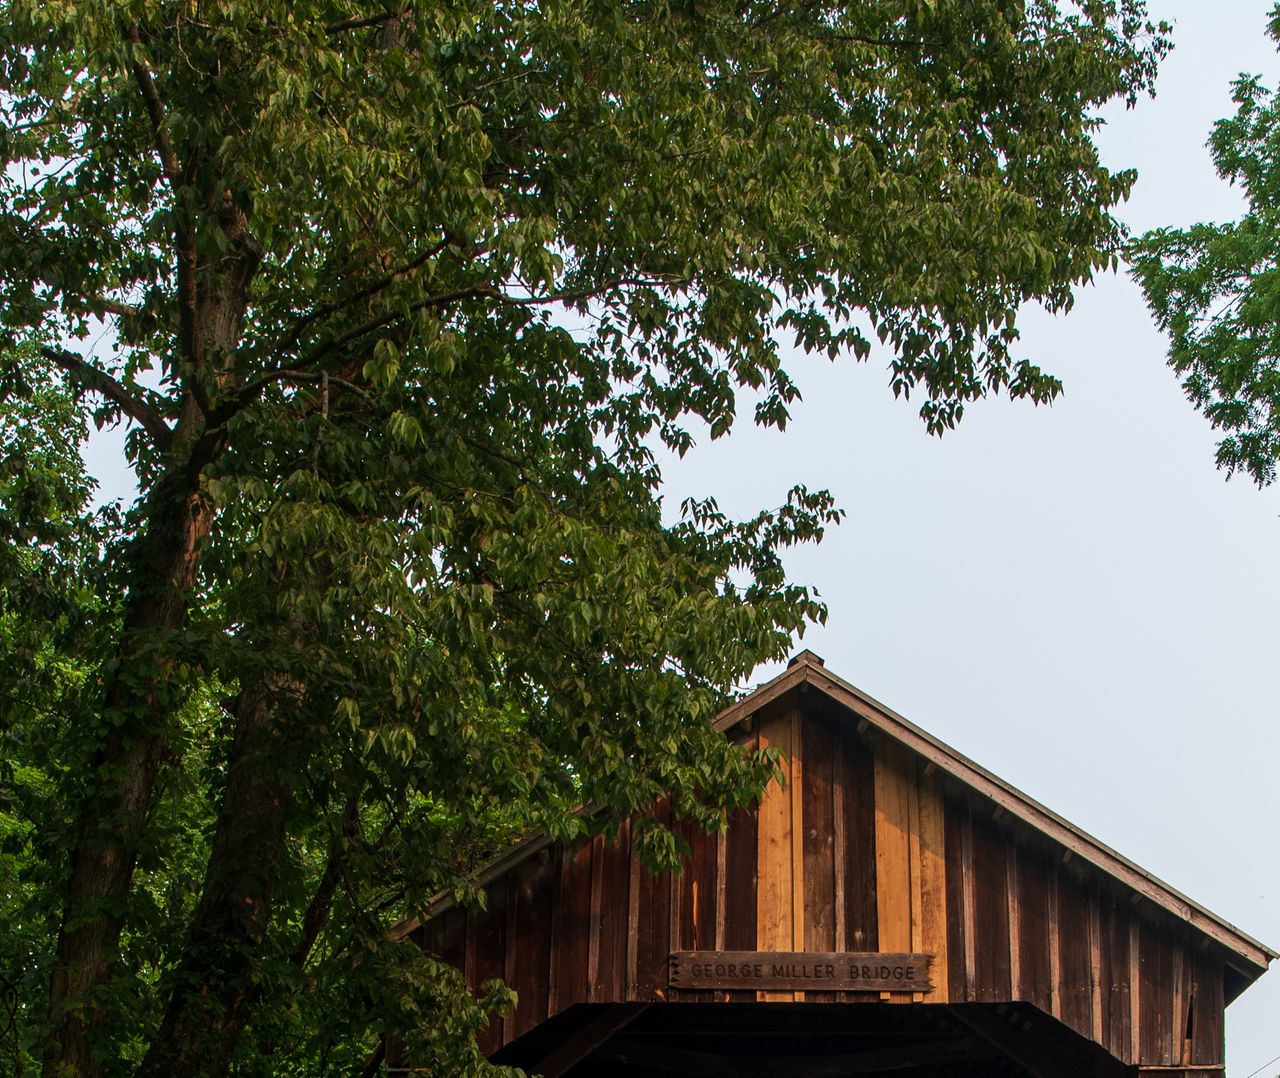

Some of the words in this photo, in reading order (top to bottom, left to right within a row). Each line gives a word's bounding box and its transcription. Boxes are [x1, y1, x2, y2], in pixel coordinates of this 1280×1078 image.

[691, 963, 763, 978] GEORGE
[772, 964, 835, 979] MILLER
[849, 965, 915, 980] BRIDGE
